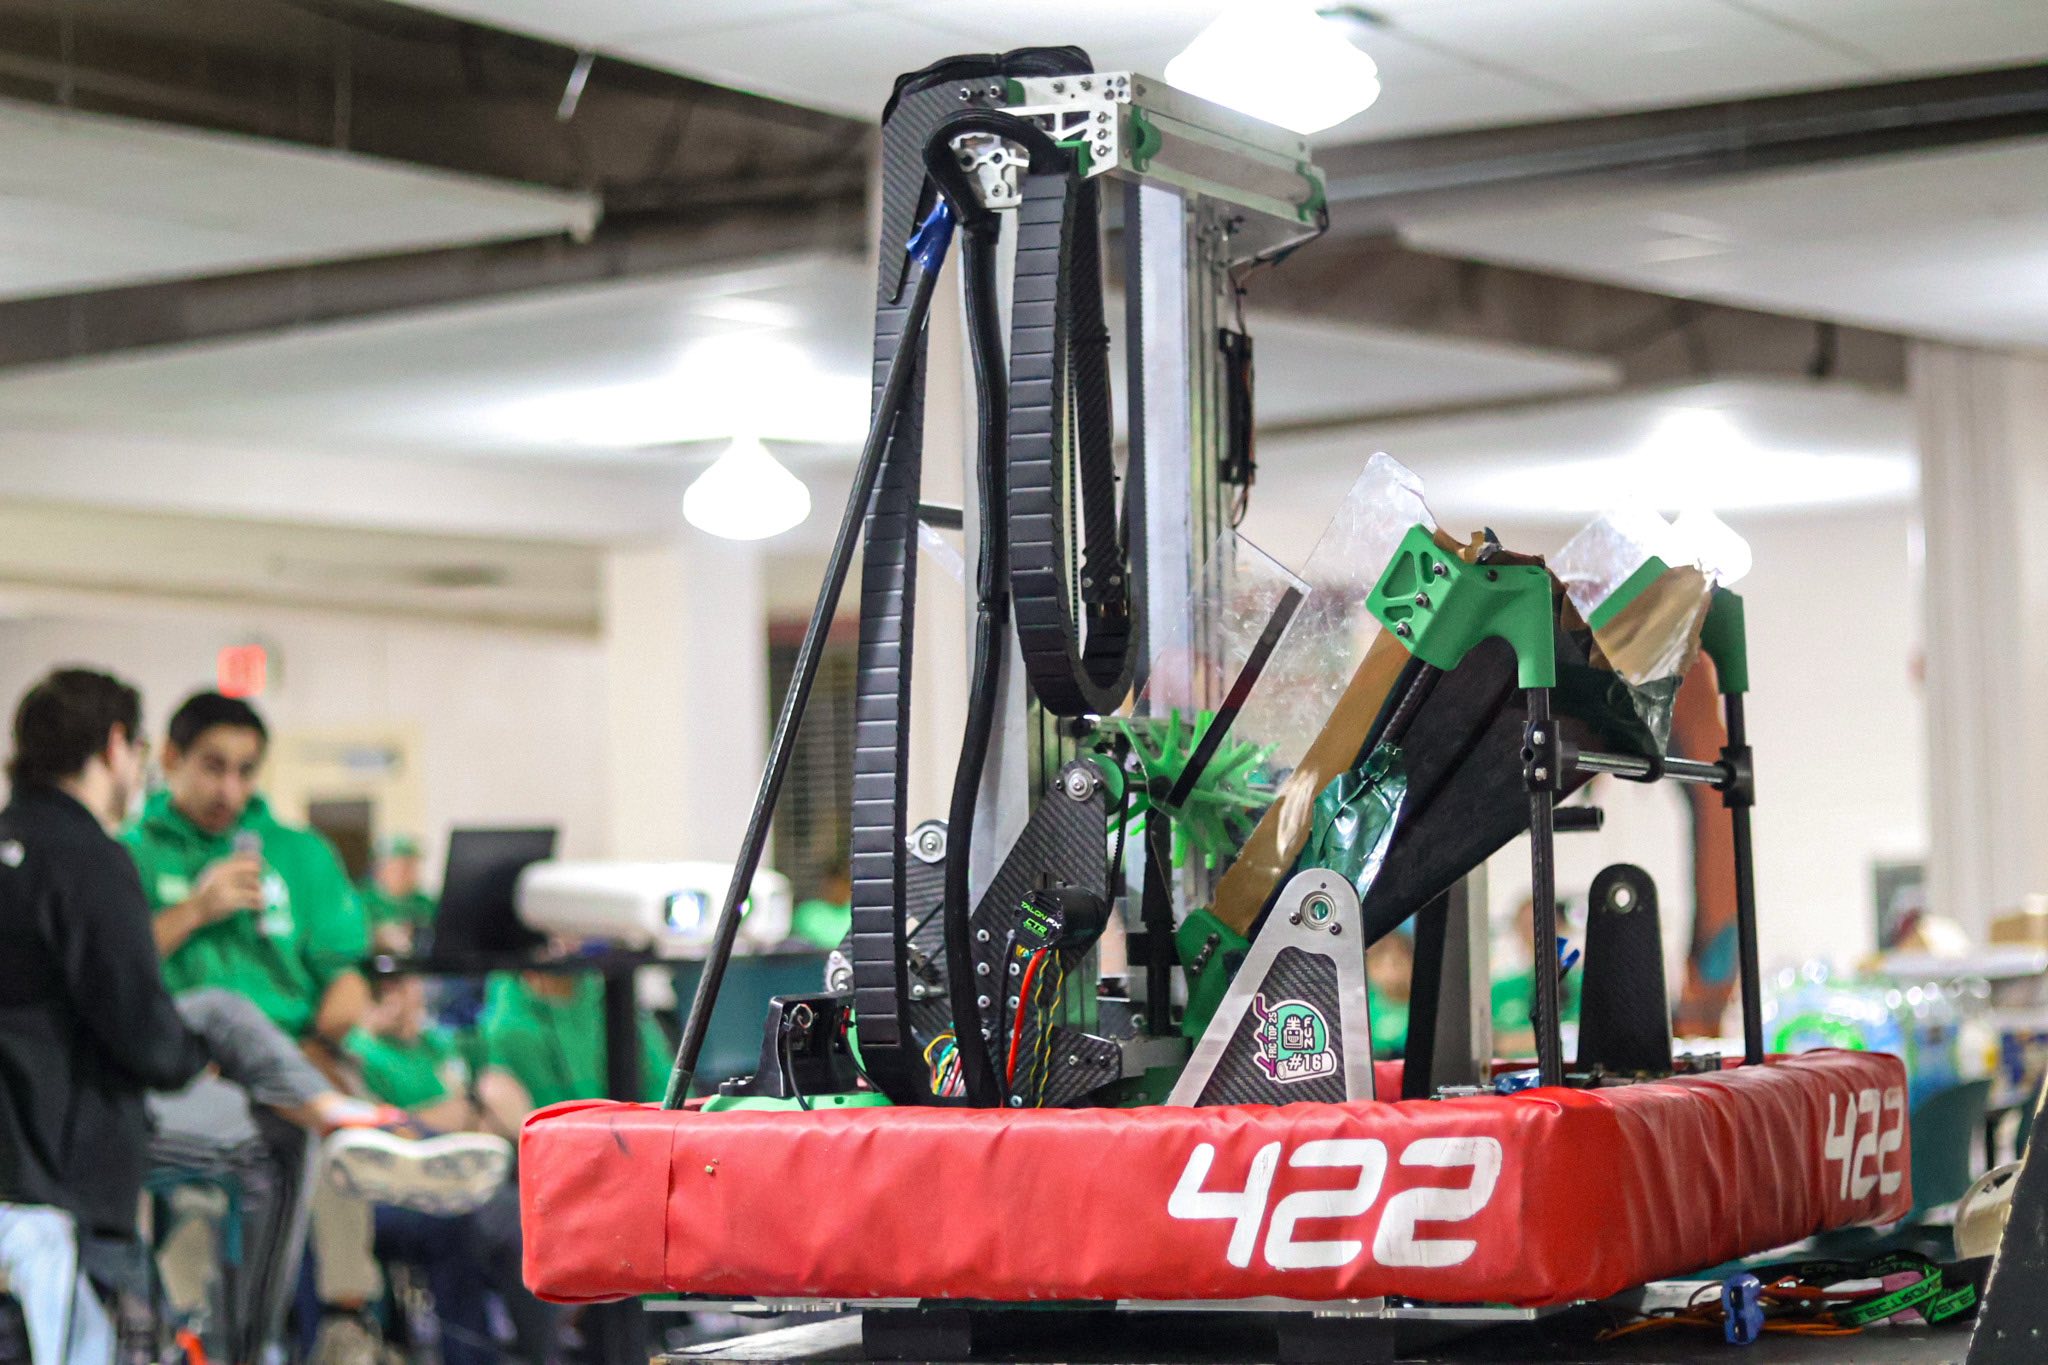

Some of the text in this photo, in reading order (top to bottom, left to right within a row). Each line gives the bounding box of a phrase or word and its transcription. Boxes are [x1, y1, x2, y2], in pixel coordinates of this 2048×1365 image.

[1021, 900, 1062, 930] TALON FX
[1024, 918, 1048, 935] CTR
[1269, 1012, 1277, 1058] FRC TOP 25
[1304, 1017, 1313, 1048] FUN
[1287, 1053, 1321, 1072] #16
[1824, 1085, 1905, 1201] 422
[1167, 1136, 1503, 1271] 422
